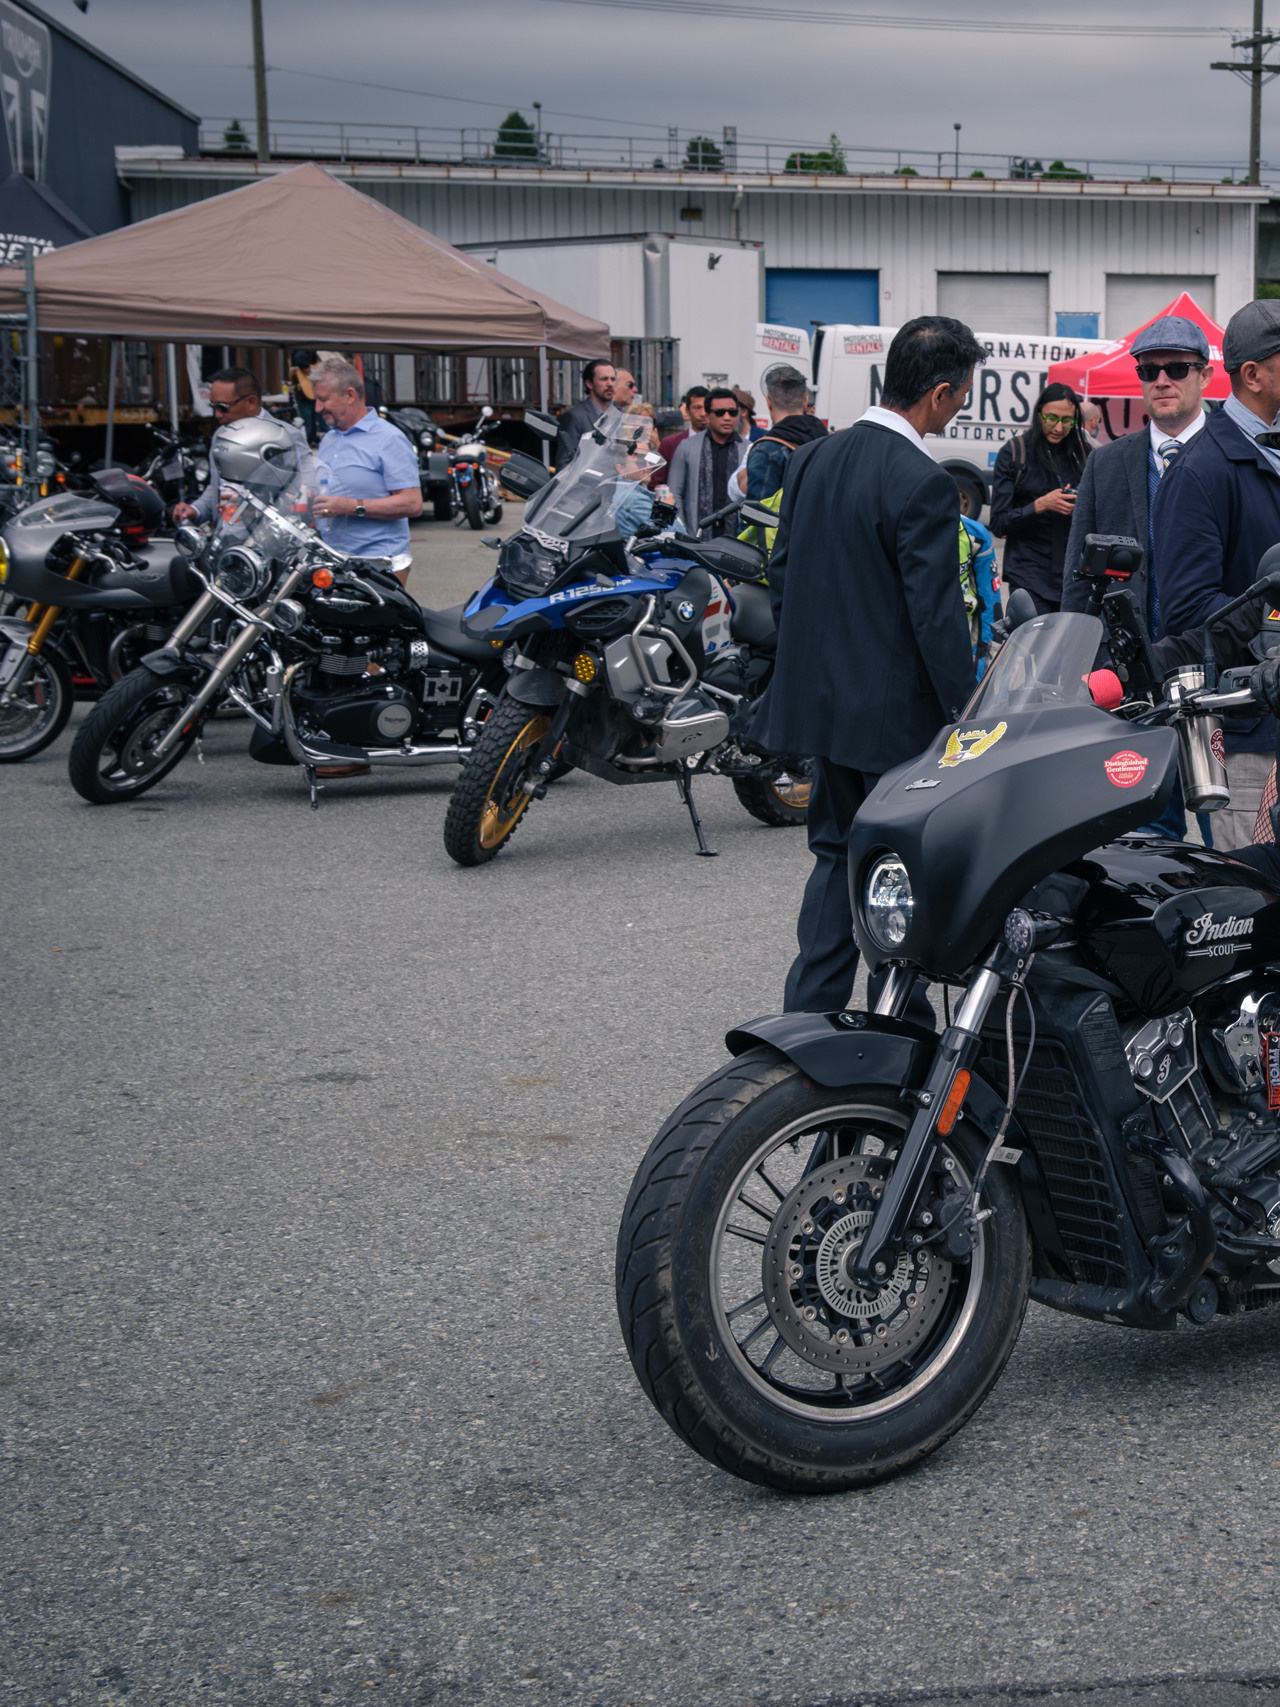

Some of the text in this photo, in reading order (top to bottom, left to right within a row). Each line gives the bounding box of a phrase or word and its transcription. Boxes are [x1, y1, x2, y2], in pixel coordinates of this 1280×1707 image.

[763, 327, 801, 342] MOTORCYCLE
[844, 334, 882, 343] MOTORCYCLE
[763, 337, 800, 354] RENTALS
[845, 342, 884, 354] RENTALS
[986, 341, 1088, 361] RNATION
[1105, 758, 1147, 767] Distinguished
[1106, 765, 1145, 773] Gentleman's
[1186, 912, 1254, 945] Indian
[1208, 943, 1235, 957] SCOUT
